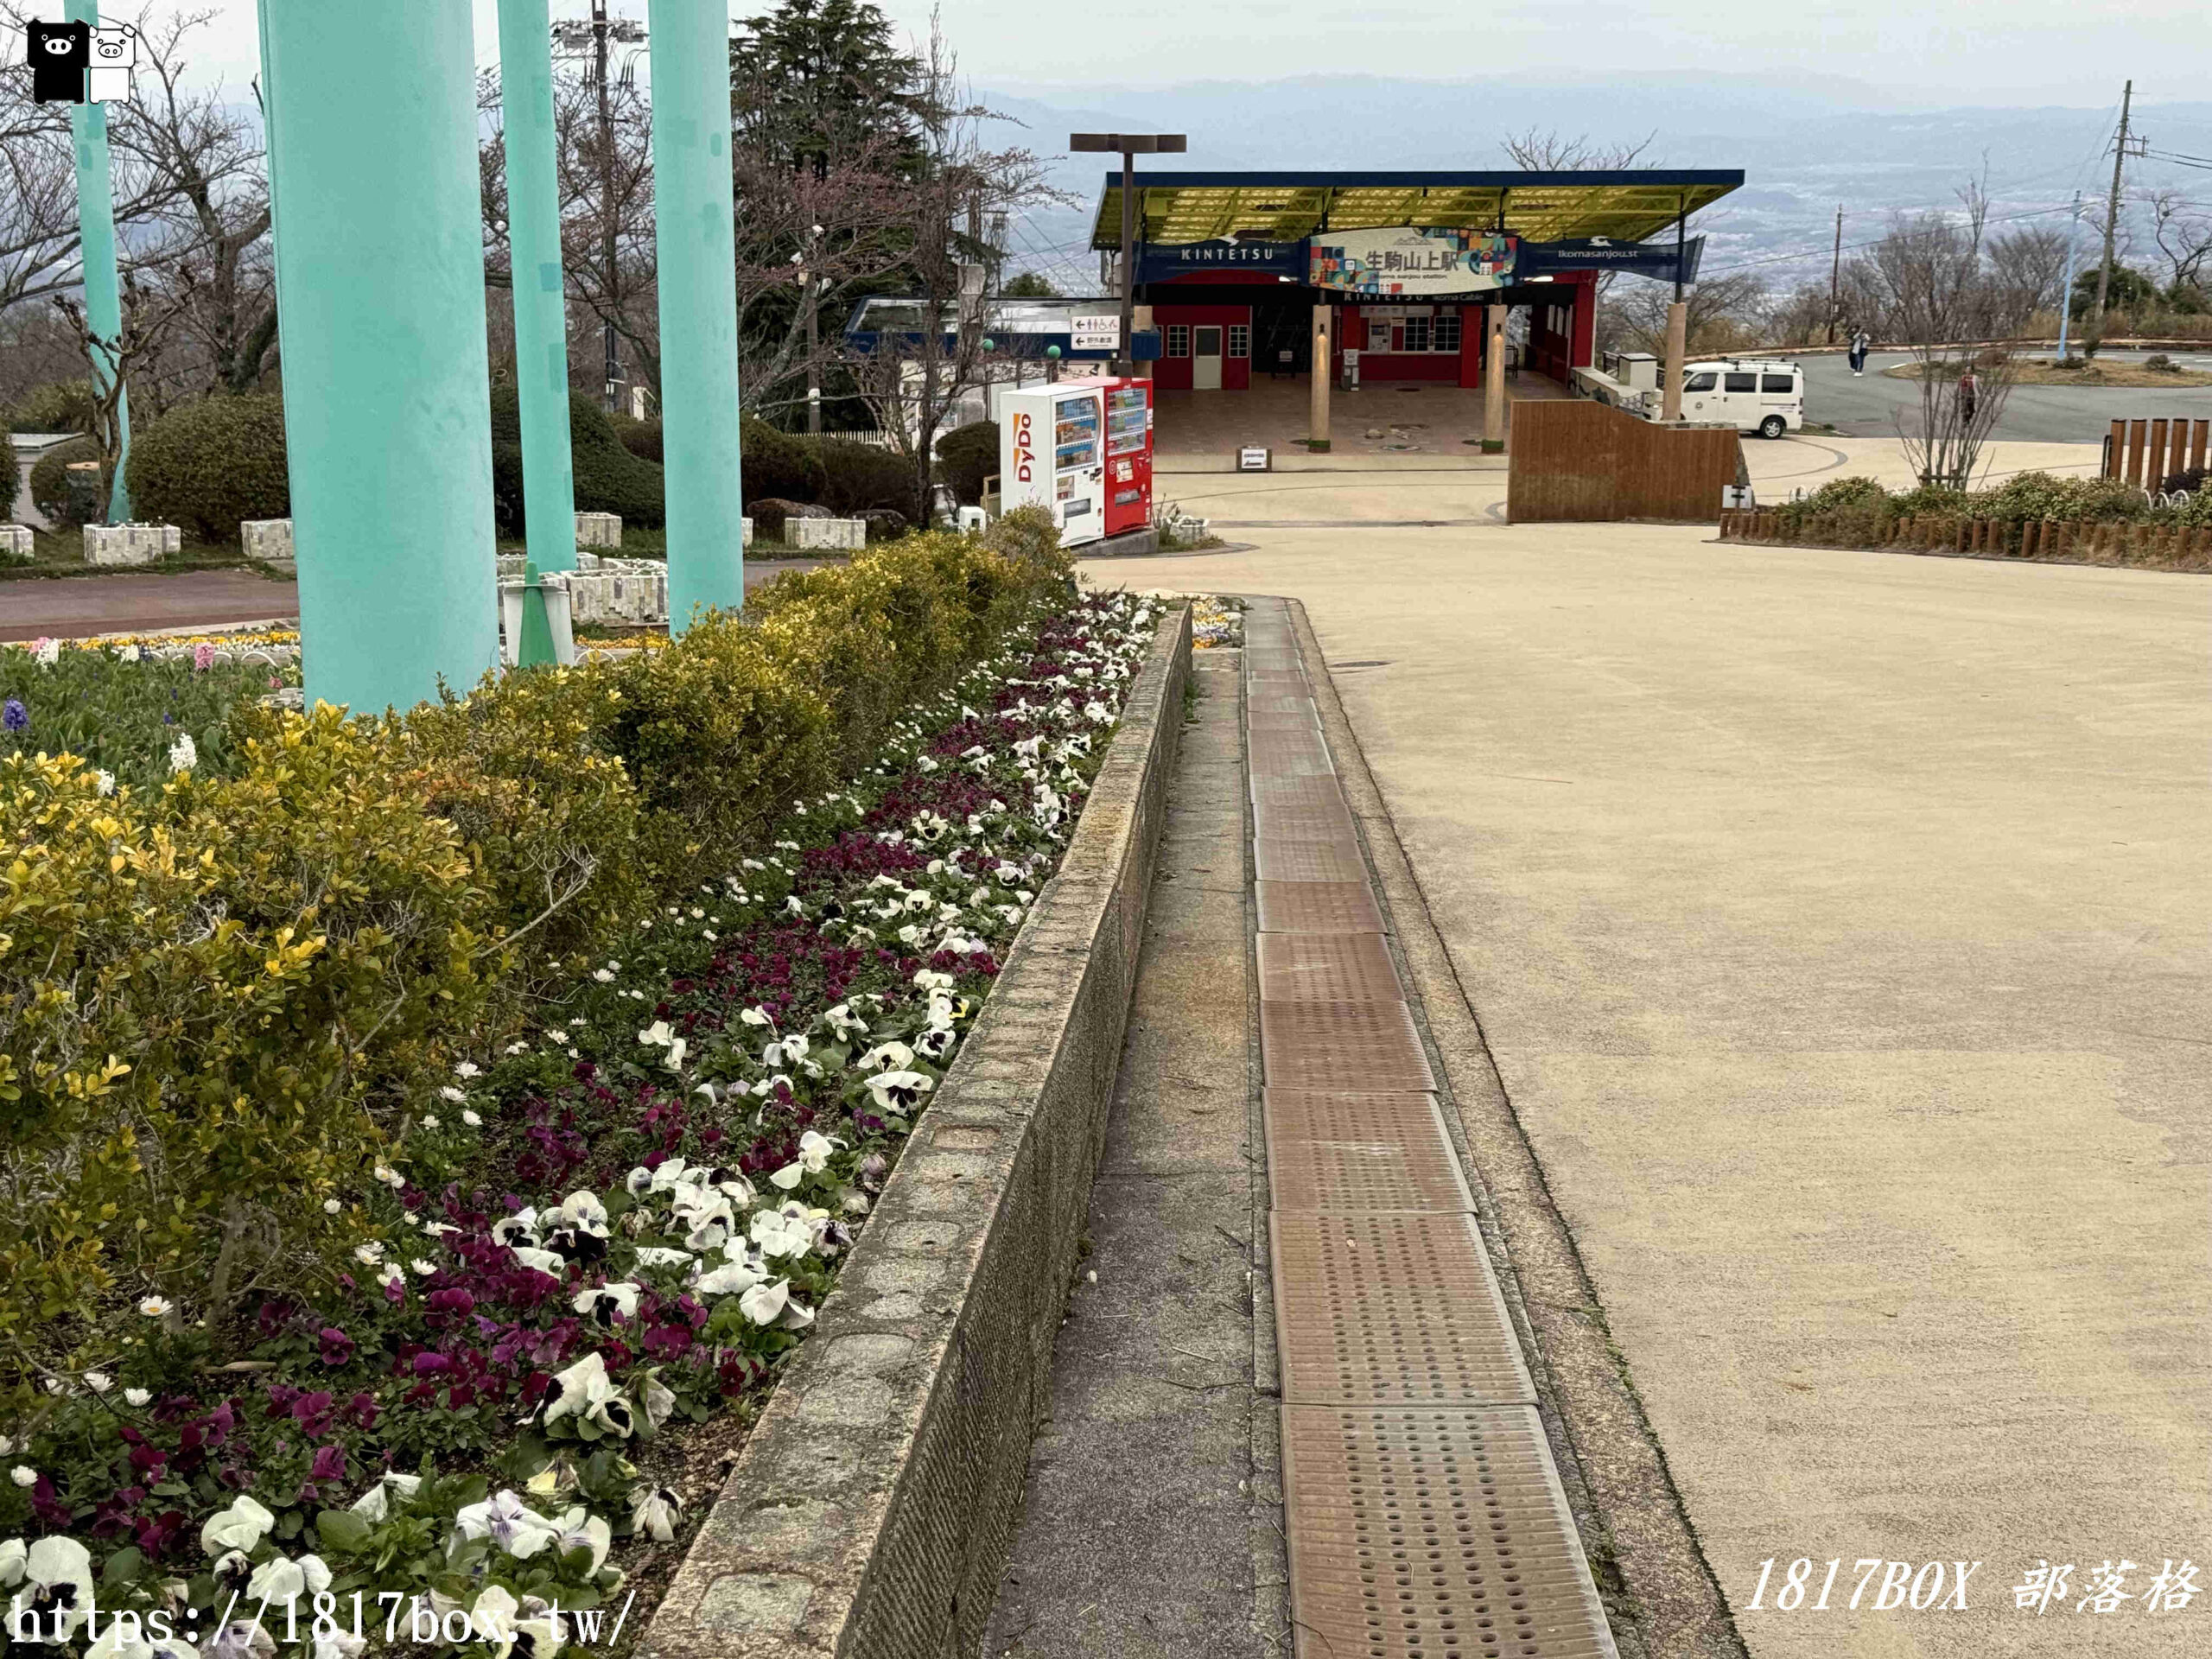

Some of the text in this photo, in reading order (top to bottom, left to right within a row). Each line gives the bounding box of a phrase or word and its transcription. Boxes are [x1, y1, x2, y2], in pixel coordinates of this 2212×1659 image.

[1181, 248, 1273, 260] KINTETSU
[1365, 250, 1459, 271] 生駒山上駅
[1019, 413, 1035, 482] DyDo
